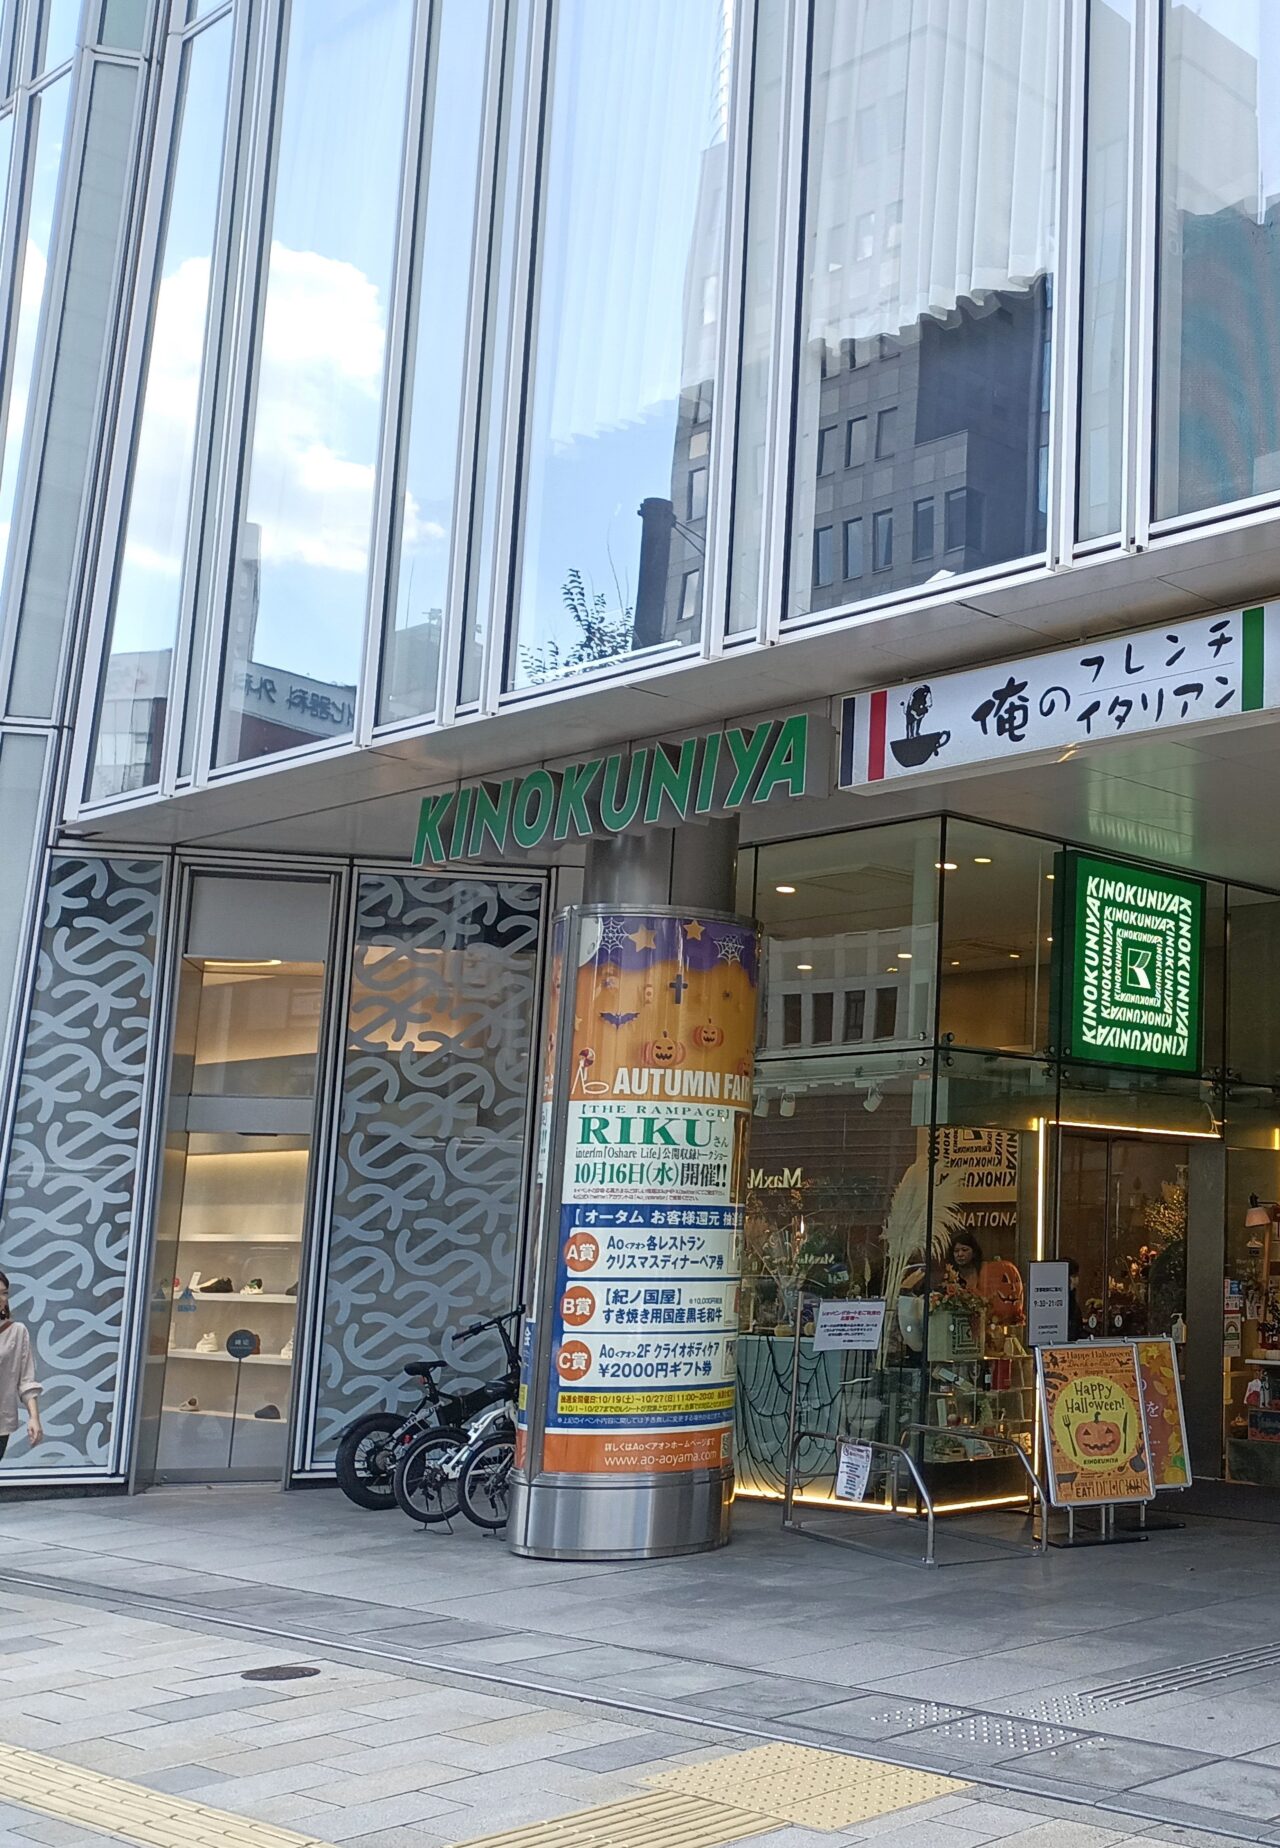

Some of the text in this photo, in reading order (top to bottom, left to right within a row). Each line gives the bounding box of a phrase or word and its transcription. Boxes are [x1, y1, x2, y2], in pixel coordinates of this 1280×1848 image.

[1080, 620, 1234, 682] フレンチ
[971, 677, 1072, 742] 俺の
[1077, 675, 1236, 734] イタリアン
[411, 713, 808, 867] KINOKUNIYA
[1087, 876, 1181, 914] KINOKUNIYA
[1104, 906, 1167, 932] KINOKUNIYA
[1082, 896, 1101, 1045] KINOKUNIYA
[1101, 920, 1114, 1019] KINOKUNIYA
[1163, 918, 1176, 1015] KINOKUNIYA
[1175, 896, 1192, 1036] KINOKUNIYA
[1108, 1005, 1172, 1028] KINOKUNIYA
[1096, 1024, 1189, 1056] KINOKUNIYA
[613, 1067, 720, 1098] AUTUMN
[650, 1210, 720, 1226] お客様還元
[566, 1246, 596, 1262] A賞
[606, 1254, 724, 1271] クリスマスディナーペア券
[562, 1297, 592, 1317] B賞
[602, 1307, 723, 1326] すき焼き用国産黒毛和牛
[558, 1351, 588, 1370] C賞
[1074, 1381, 1113, 1400] Happy
[1065, 1397, 1125, 1414] Halloween!
[604, 1450, 717, 1467] www.ao-aoyama.com
